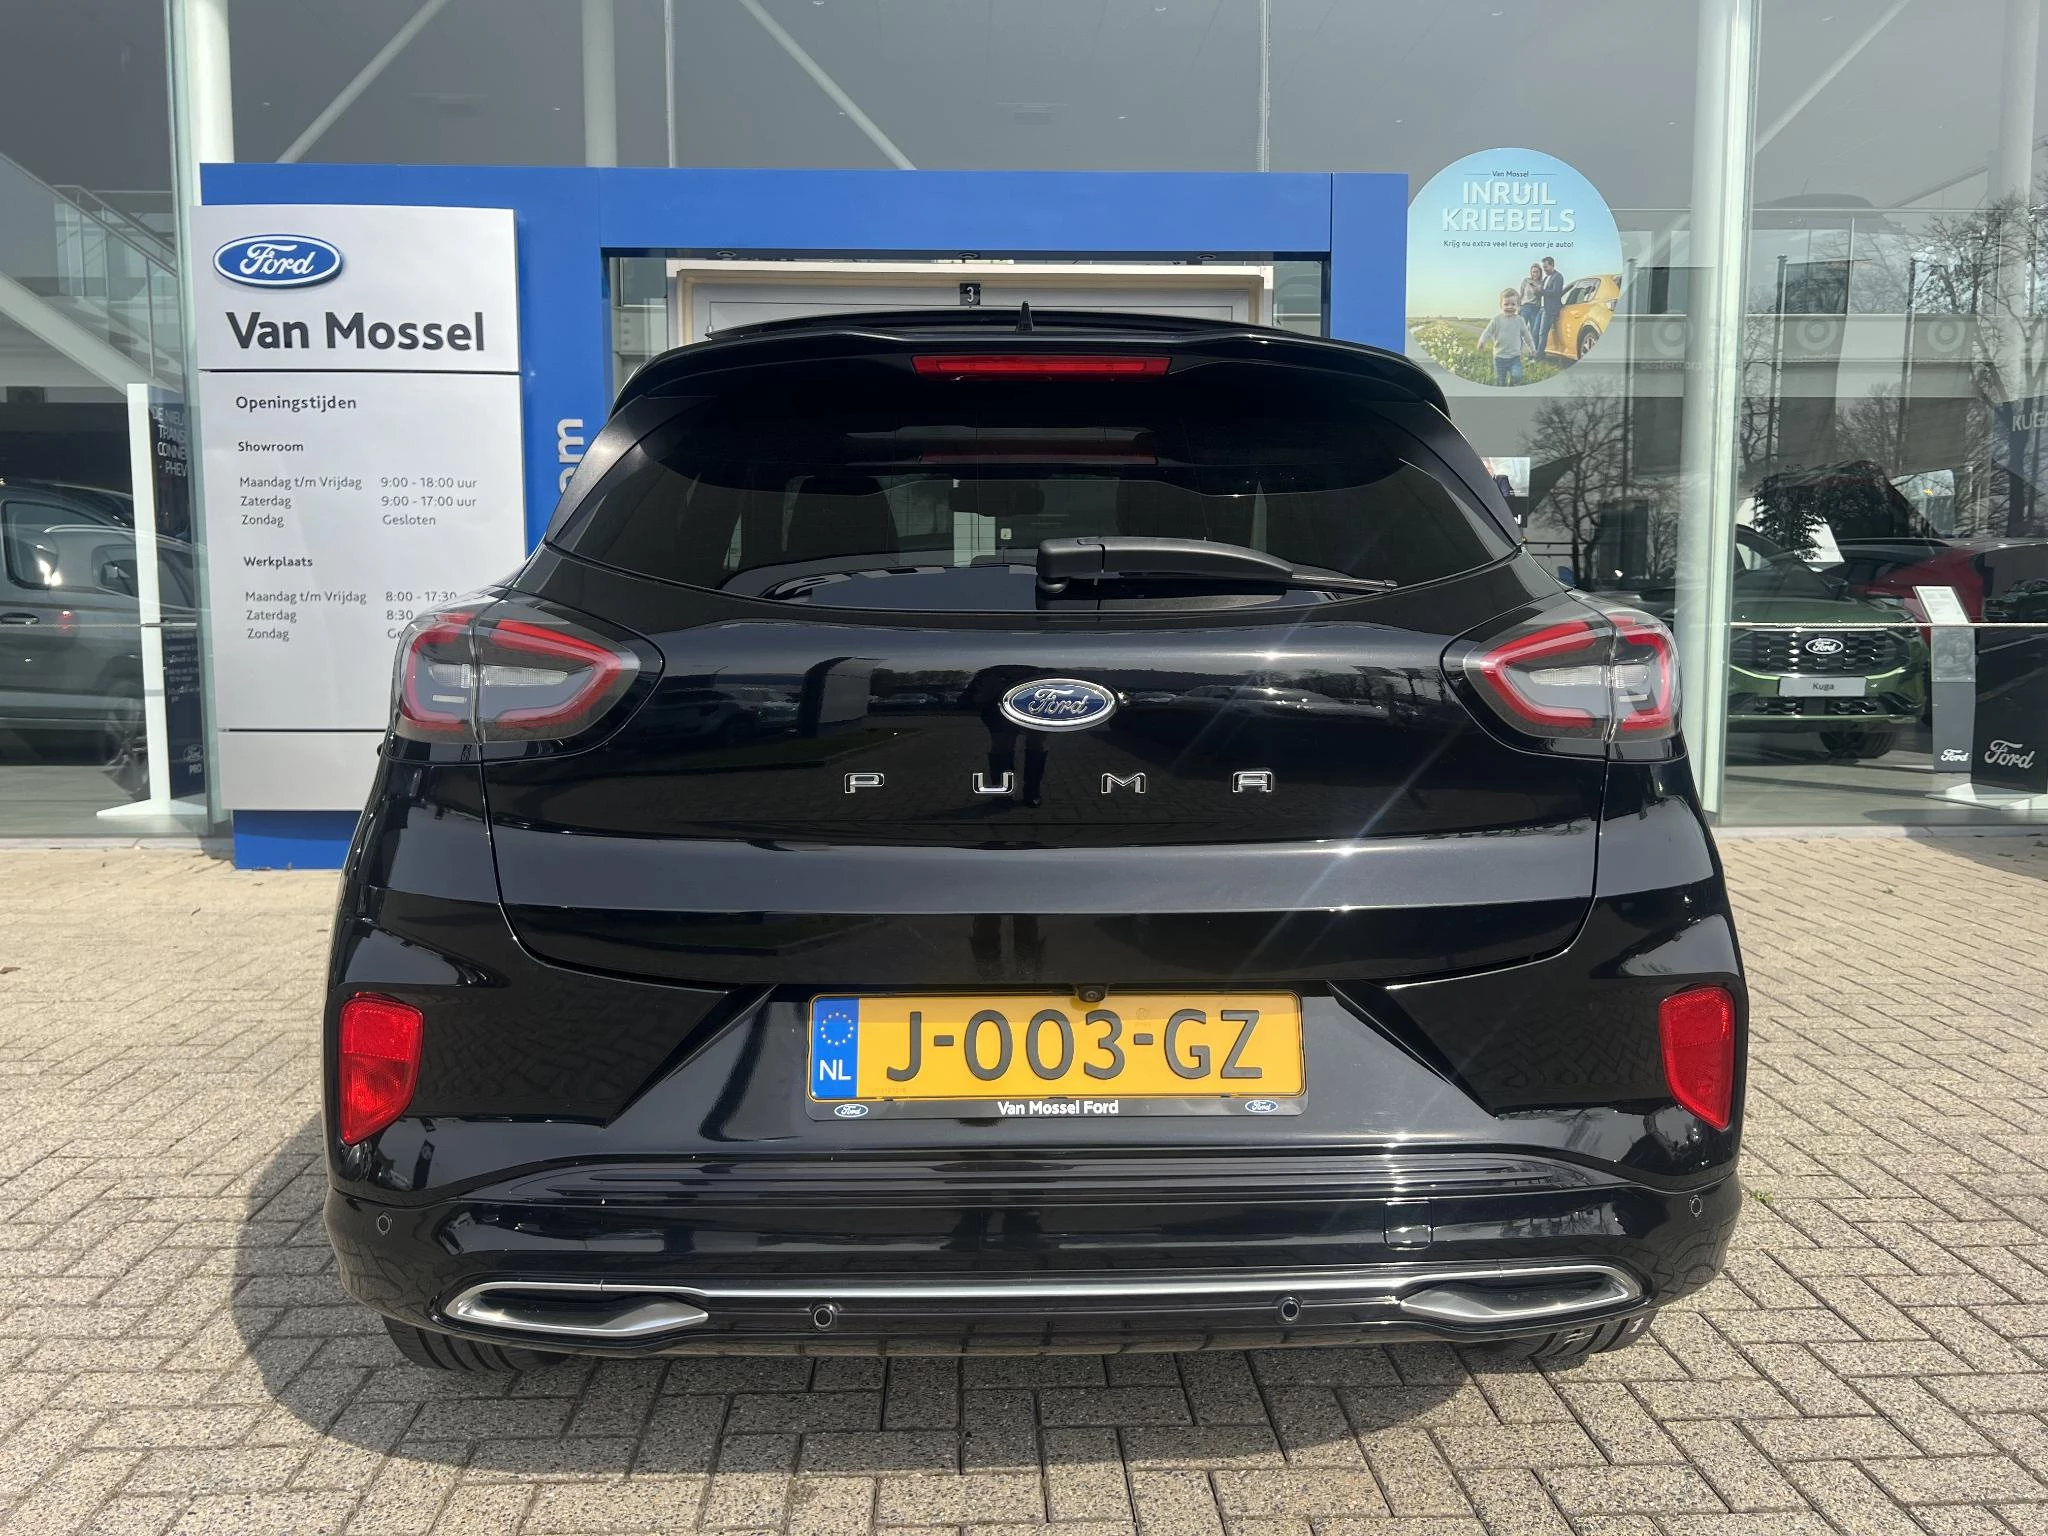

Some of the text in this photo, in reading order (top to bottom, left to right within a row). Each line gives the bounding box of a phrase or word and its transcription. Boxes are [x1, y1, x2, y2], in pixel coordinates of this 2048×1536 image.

[1463, 180, 1557, 205] INRUIL
[1442, 208, 1577, 233] KRIEBELS
[1443, 240, 1461, 248] Krijg
[1509, 241, 1528, 249] terug
[1546, 241, 1554, 249] je
[239, 242, 314, 275] Ford
[967, 286, 976, 303] 3
[225, 311, 485, 351] Van Mossel
[235, 395, 357, 413] Openingstijden
[237, 440, 304, 453] Showroom
[239, 476, 291, 491] Maandag
[295, 476, 317, 488] t/m
[320, 476, 363, 492] Vrijdag
[380, 476, 409, 488] 9:00
[420, 476, 454, 488] 18:00
[457, 479, 477, 488] uur
[240, 495, 292, 510] Zaterdag
[381, 495, 409, 507] 9:00
[420, 495, 454, 507] 17:00
[456, 498, 477, 507] uur
[241, 514, 436, 529] Zondag Gesloten
[243, 555, 313, 570] Werkplaats
[245, 591, 297, 605] Maandag
[299, 591, 322, 602] t/m
[324, 591, 367, 605] Vrijdag
[385, 591, 413, 602] 8:00
[246, 609, 414, 624] Zaterdag 8:30
[247, 628, 290, 642] Zondag
[1812, 641, 1837, 652] Ford
[1812, 683, 1835, 691] Kuga
[1027, 687, 1089, 715] Ford
[1940, 749, 1969, 762] Ford
[1984, 739, 2036, 769] Ford
[844, 771, 1275, 795] PUMA
[886, 1008, 1263, 1082] J-003-GZ
[819, 1059, 852, 1081] NL
[841, 1105, 862, 1115] Ford
[997, 1100, 1119, 1115] Van Mossel Ford
[1252, 1101, 1272, 1111] Ford
